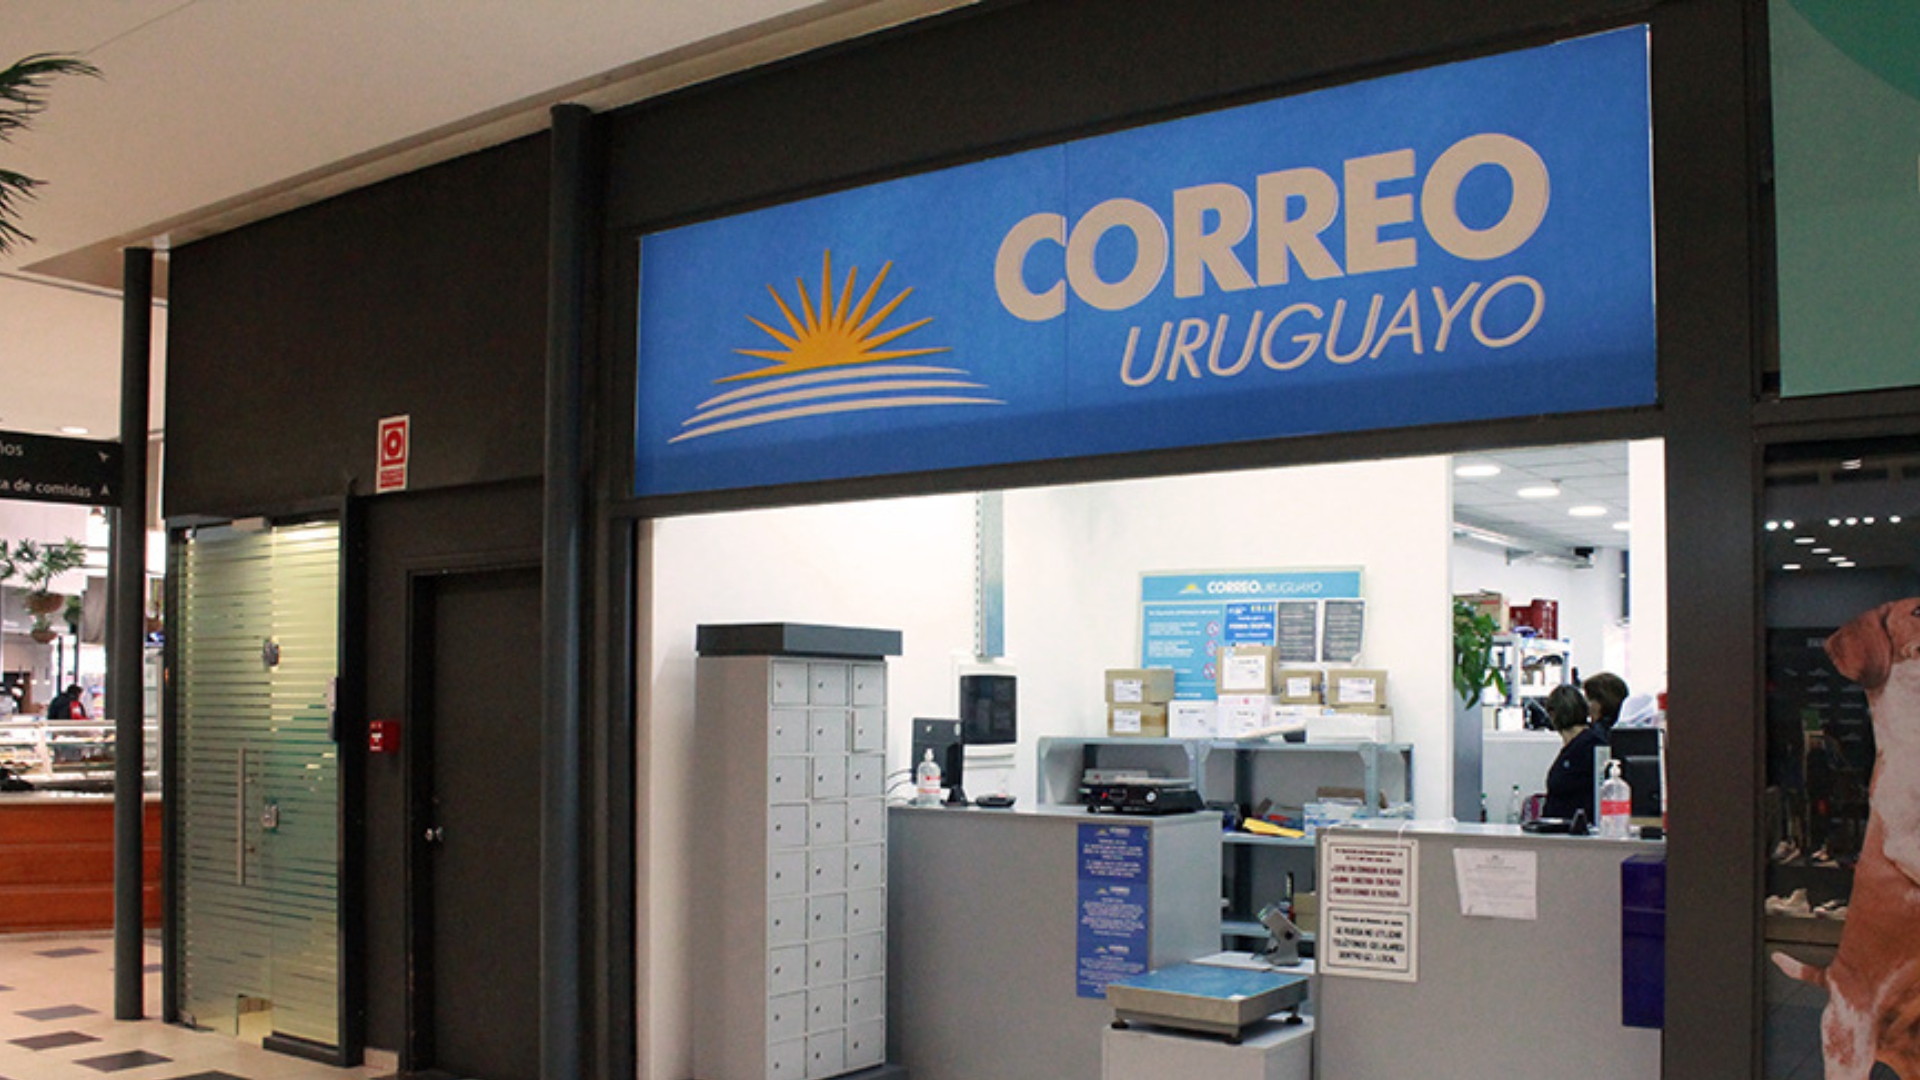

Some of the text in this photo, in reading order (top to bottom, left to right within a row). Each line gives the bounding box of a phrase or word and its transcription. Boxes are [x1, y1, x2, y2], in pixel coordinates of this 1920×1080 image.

[994, 132, 1551, 321] CORREO
[1120, 274, 1546, 387] URUGUAYO
[13, 478, 31, 492] de
[35, 482, 92, 498] comidas
